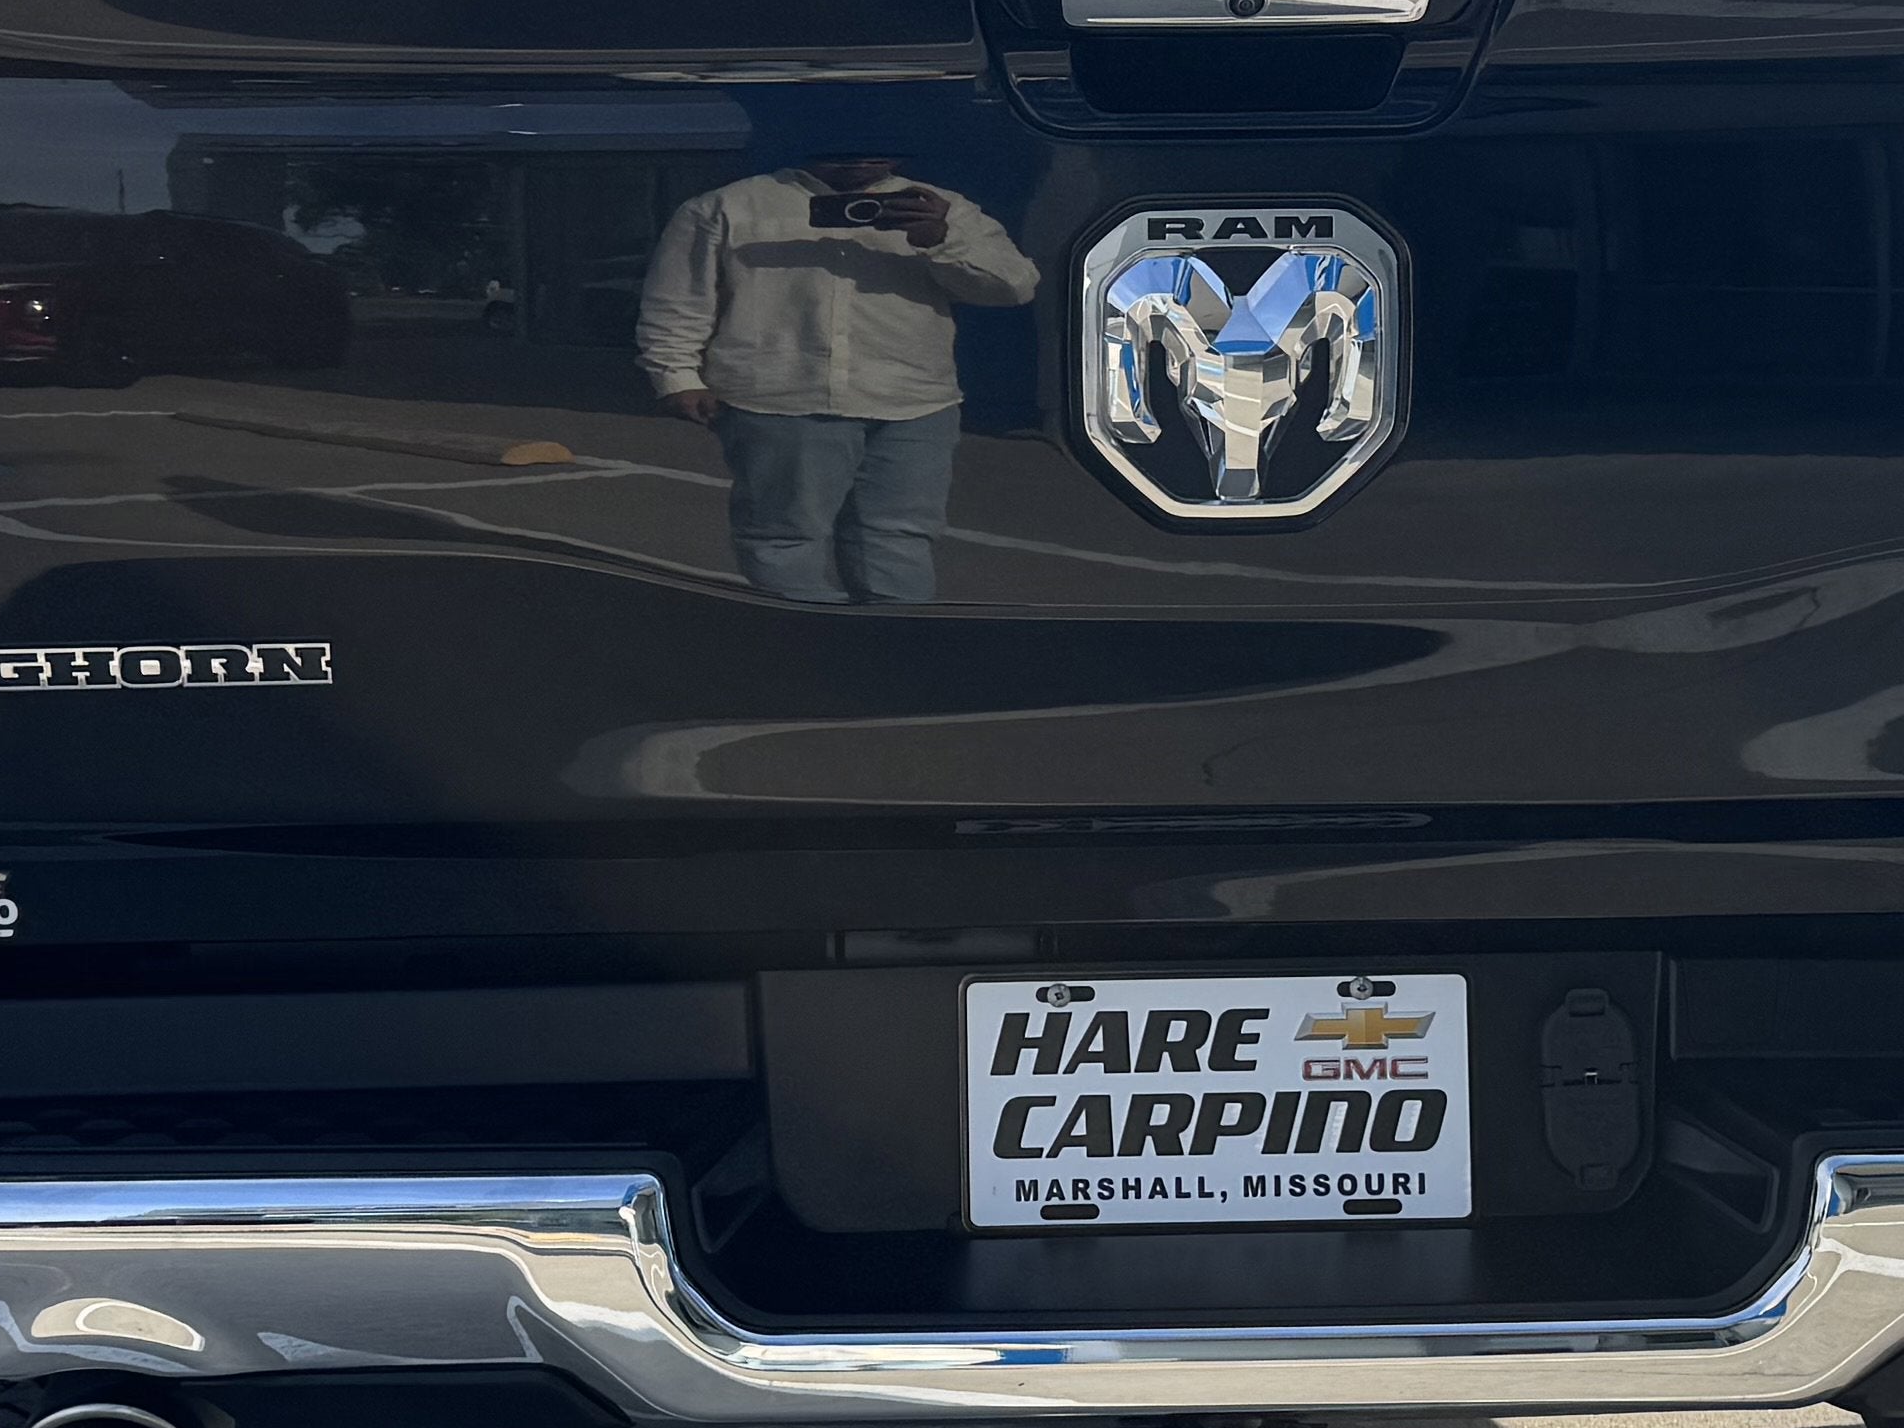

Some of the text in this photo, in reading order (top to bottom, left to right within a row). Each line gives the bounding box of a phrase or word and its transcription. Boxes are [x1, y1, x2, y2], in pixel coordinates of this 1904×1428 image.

[1146, 215, 1335, 241] RAM
[990, 1008, 1271, 1076] HARE
[1301, 1055, 1430, 1081] GMC
[993, 1088, 1449, 1160] CARPINO
[1014, 1172, 1428, 1204] MARSHALL, MISSOURI
